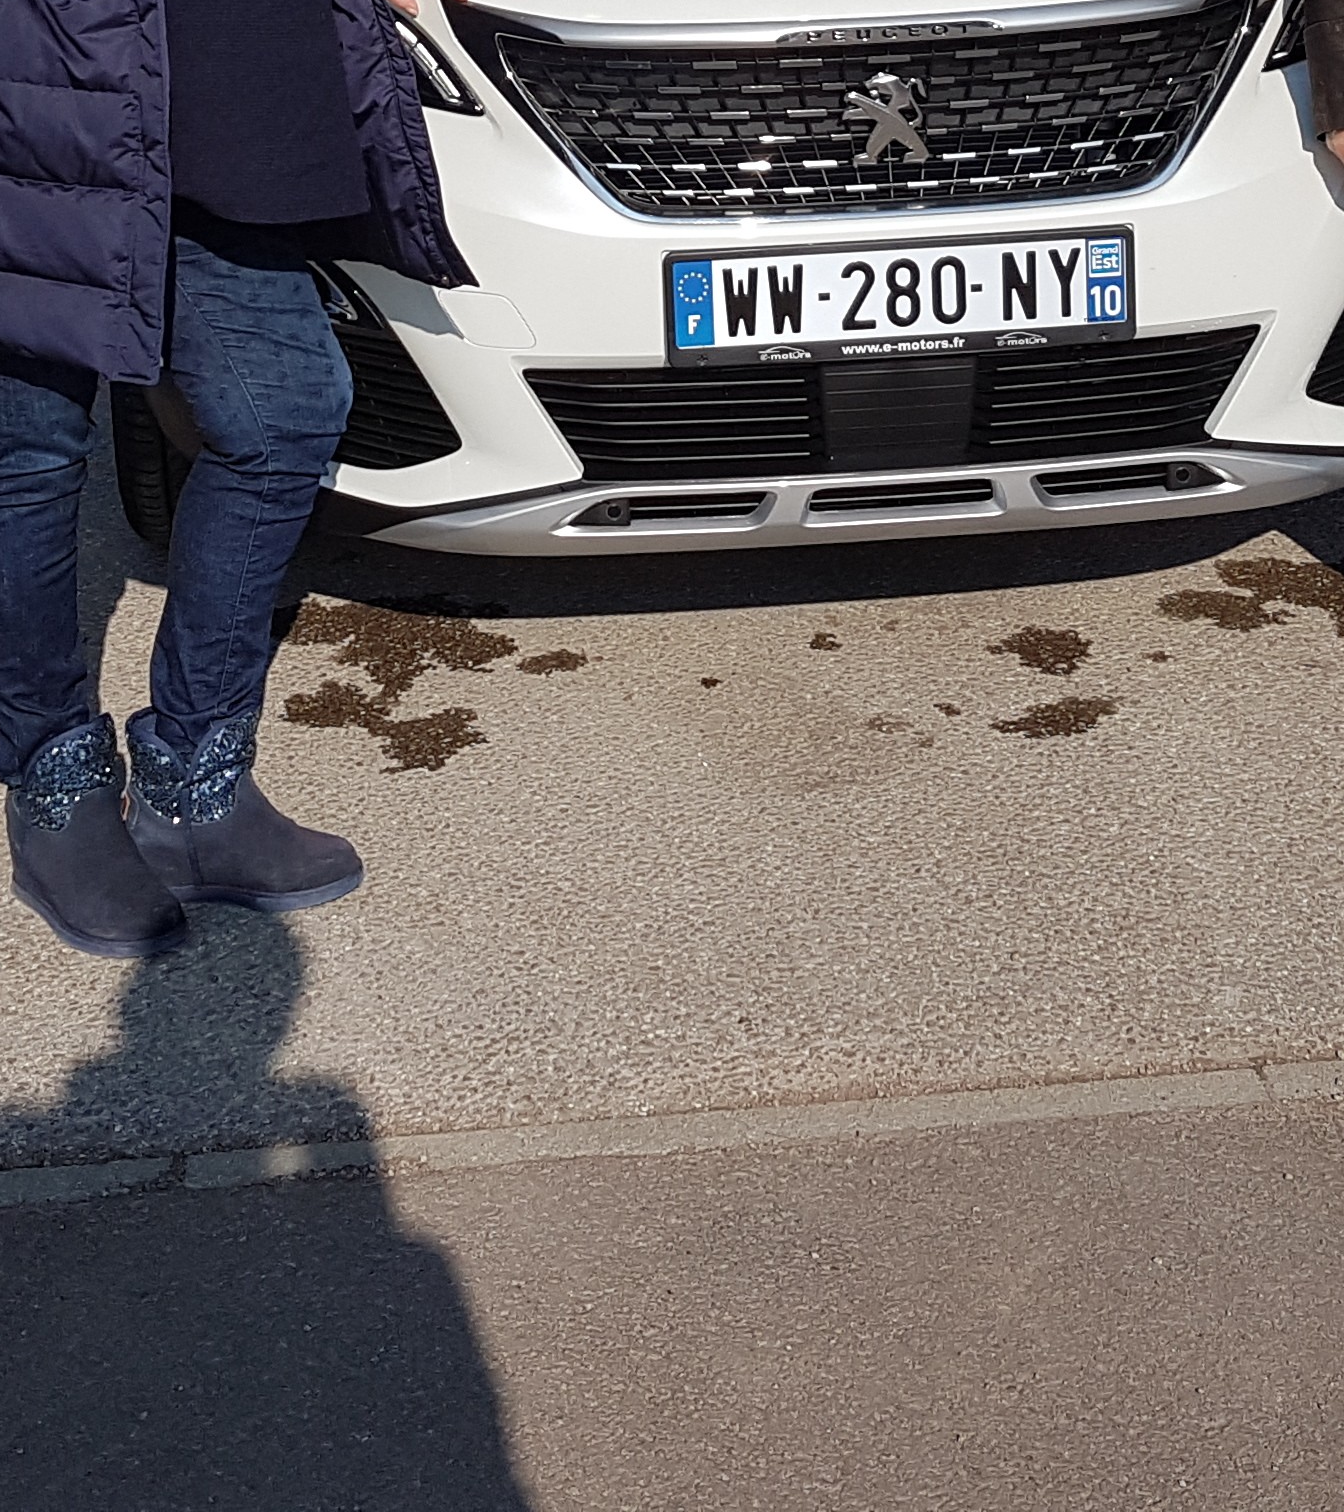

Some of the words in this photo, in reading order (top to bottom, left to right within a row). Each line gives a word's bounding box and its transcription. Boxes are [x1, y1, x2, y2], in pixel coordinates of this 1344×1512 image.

[806, 24, 969, 43] PEUGEOT
[1091, 246, 1119, 255] Grand
[1091, 255, 1119, 270] Est
[1090, 284, 1122, 317] 10
[687, 315, 701, 335] F
[841, 337, 966, 355] www.e-motors.fr
